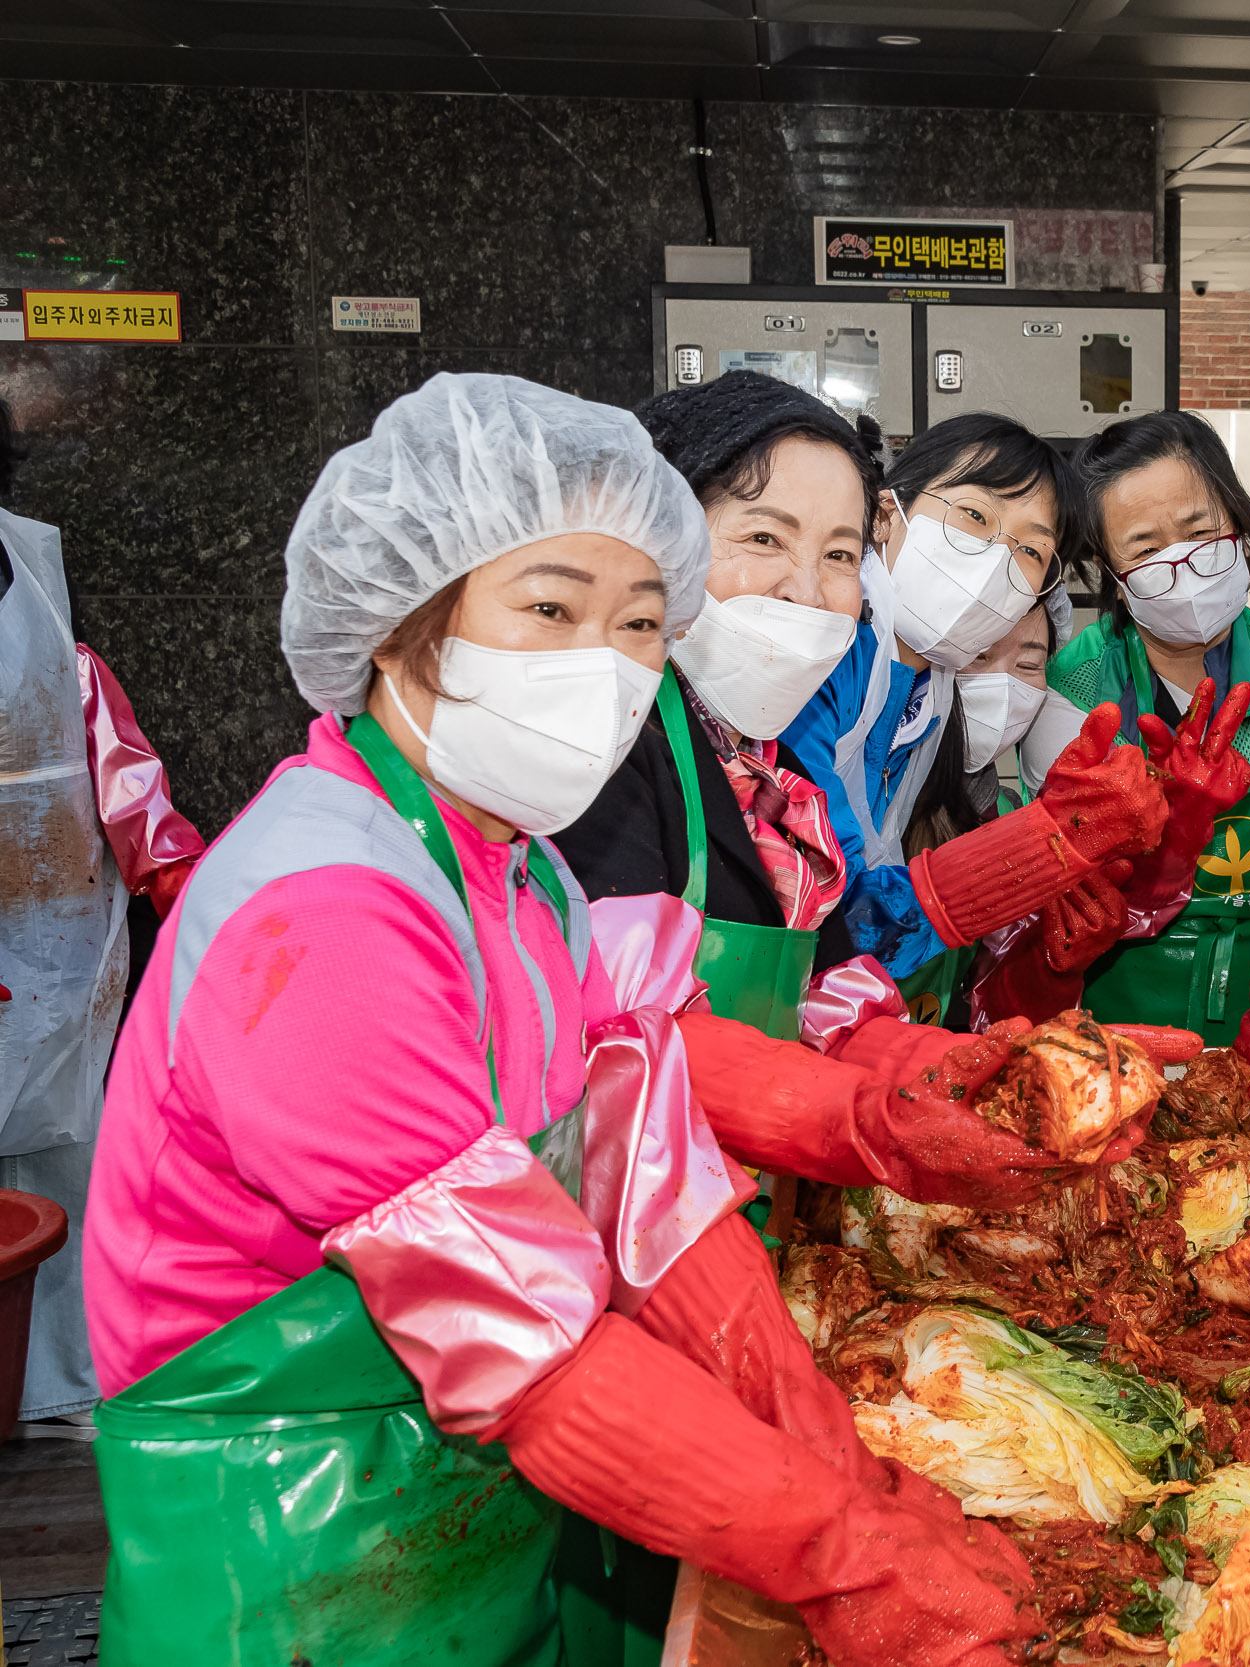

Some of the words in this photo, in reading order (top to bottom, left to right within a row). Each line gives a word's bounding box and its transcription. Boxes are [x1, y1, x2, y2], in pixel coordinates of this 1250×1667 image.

[873, 235, 1005, 270] 무인택배보관함
[833, 270, 866, 278] 0022.co.kr
[772, 319, 796, 329] 01
[1030, 324, 1055, 334] 02
